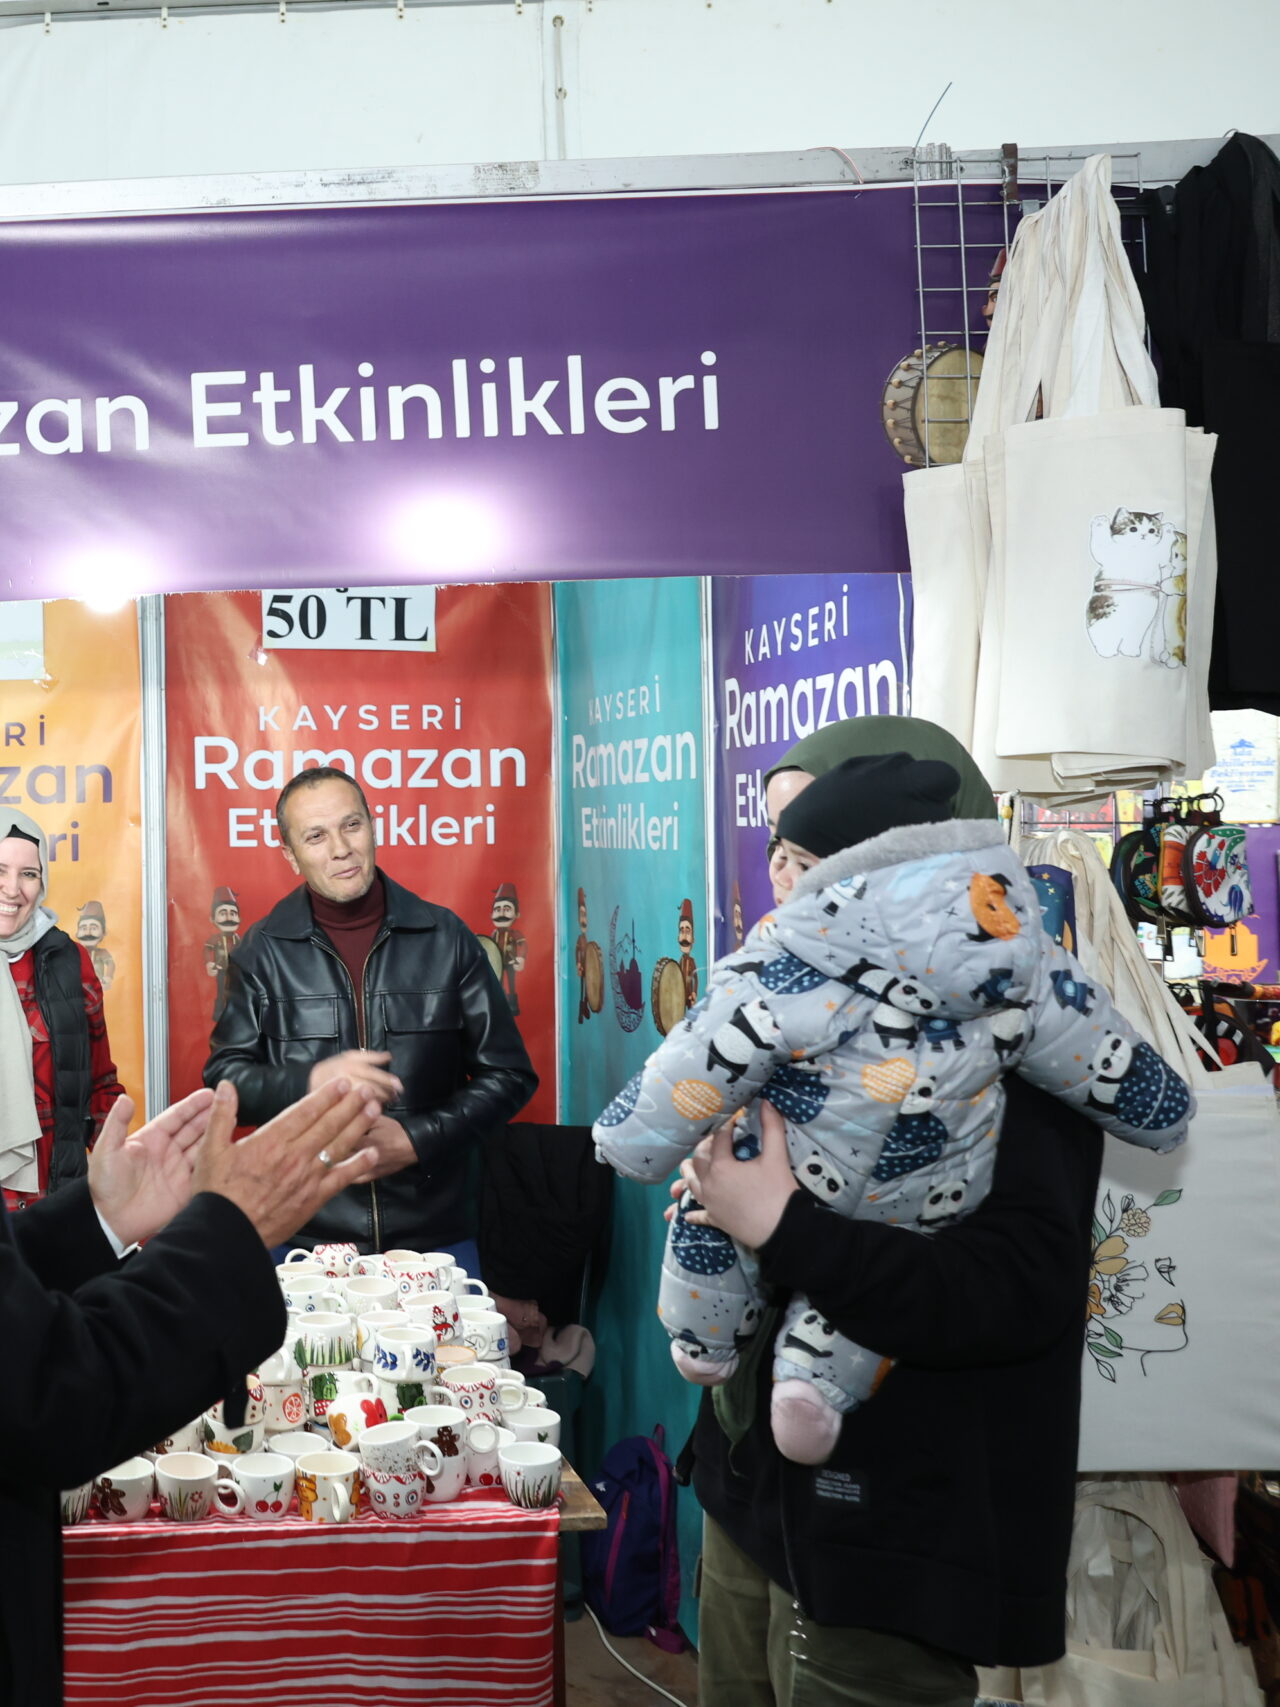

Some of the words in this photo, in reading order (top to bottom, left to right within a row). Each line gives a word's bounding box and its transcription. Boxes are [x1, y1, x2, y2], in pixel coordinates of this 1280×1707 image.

[190, 350, 719, 448] Etkinlikleri
[266, 594, 327, 640] 50
[345, 596, 429, 642] TL
[745, 584, 848, 665] KAYSERİ
[259, 697, 462, 732] KAYSERİ
[588, 675, 661, 726] KAYSERİ
[725, 659, 897, 749] Ramazan
[572, 731, 697, 789] Ramazan
[228, 804, 495, 848] Etikleri
